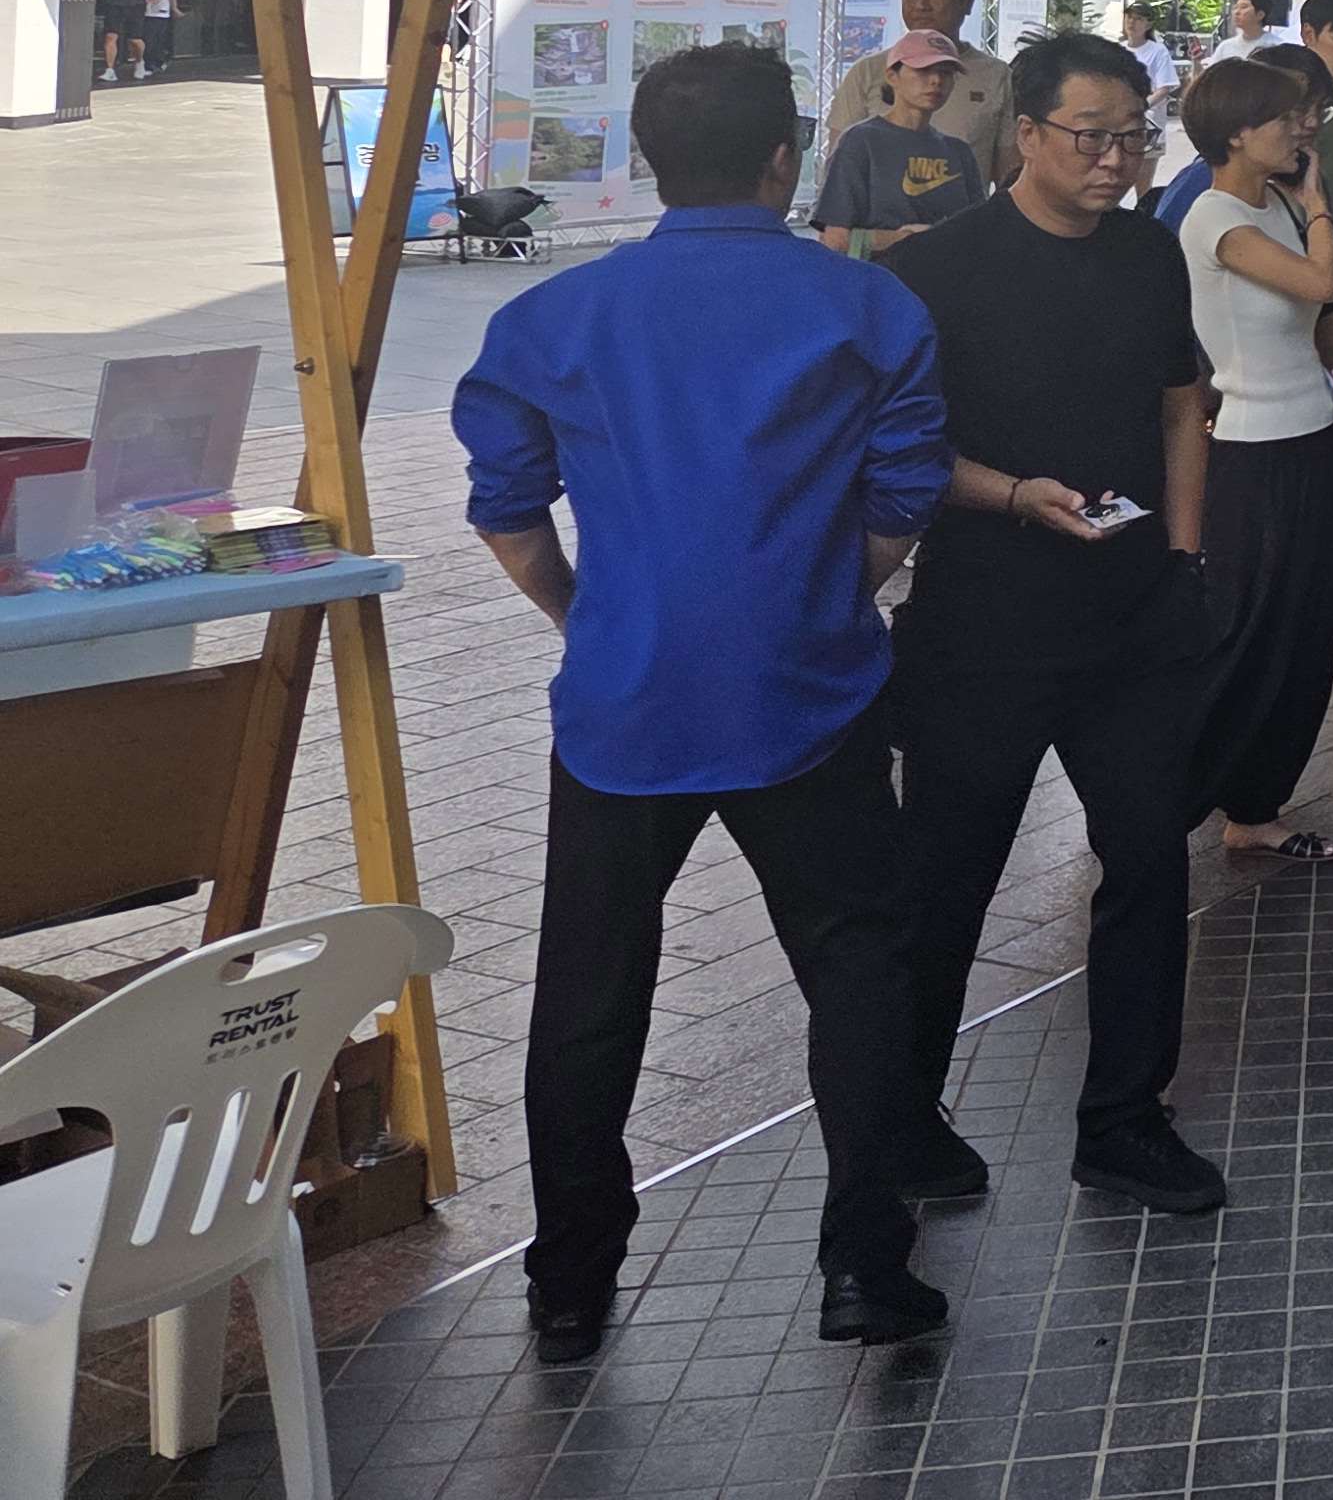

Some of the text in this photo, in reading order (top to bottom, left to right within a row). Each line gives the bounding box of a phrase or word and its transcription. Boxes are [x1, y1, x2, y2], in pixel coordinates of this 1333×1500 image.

[908, 156, 948, 180] NIKE
[221, 988, 301, 1025] TRUST
[209, 1009, 300, 1048] RENTAL
